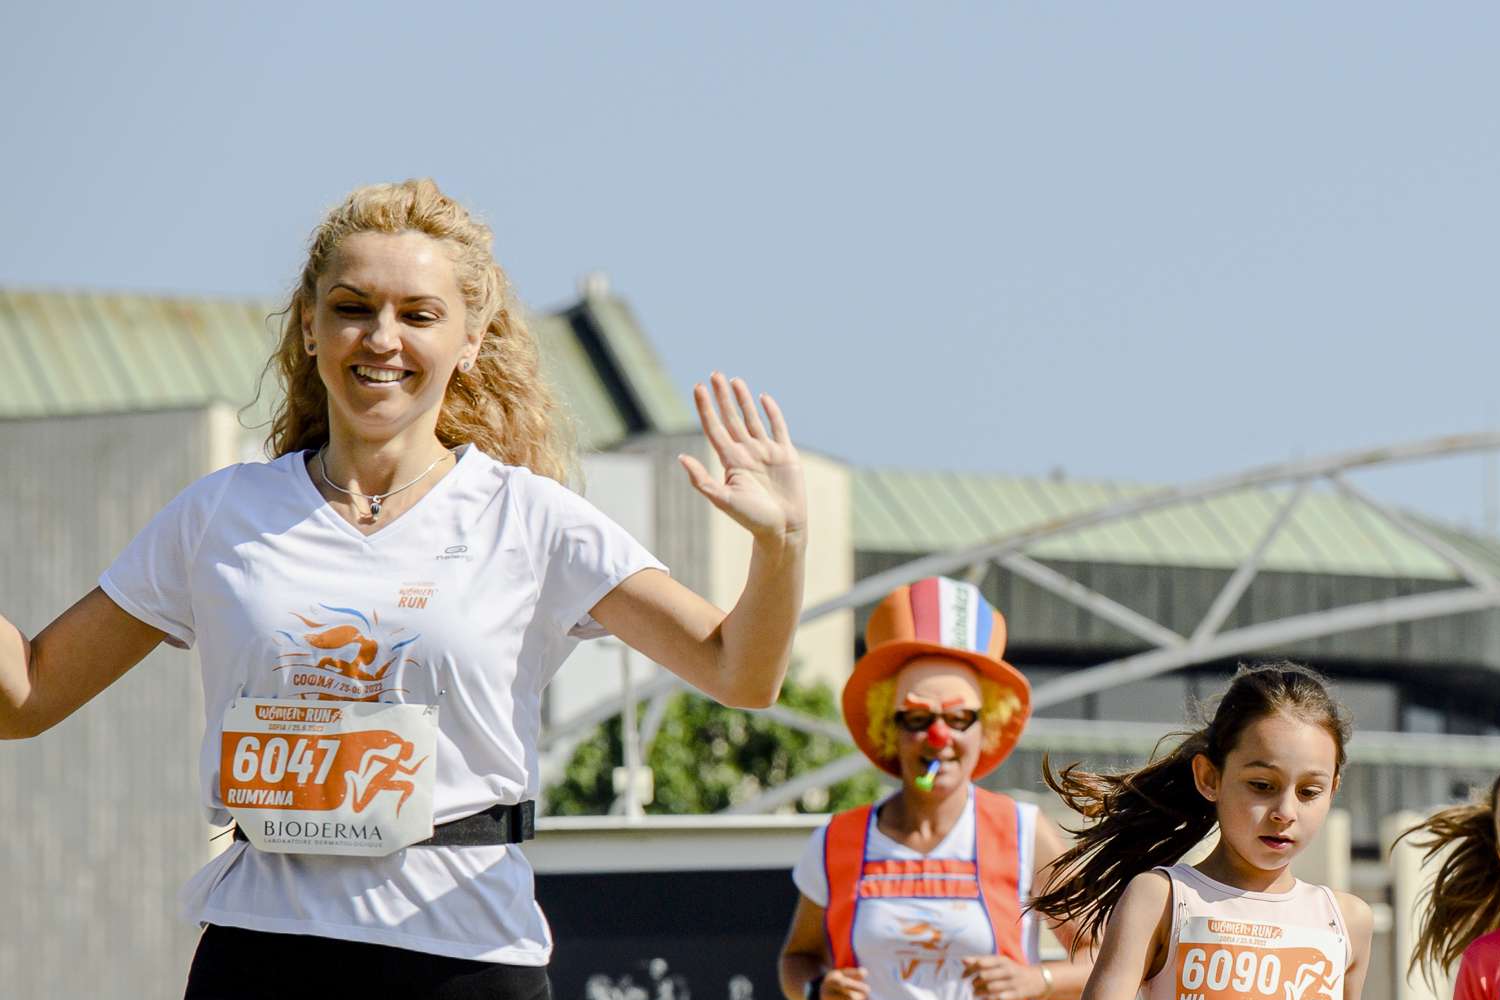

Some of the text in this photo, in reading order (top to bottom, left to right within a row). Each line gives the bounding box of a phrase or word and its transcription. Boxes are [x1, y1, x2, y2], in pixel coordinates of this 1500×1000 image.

[398, 596, 428, 609] RUN
[305, 708, 331, 722] RUN
[232, 736, 341, 785] 6047
[228, 788, 294, 806] RUMYANA
[264, 820, 382, 840] BIODERMA
[1252, 925, 1273, 938] RUN
[1182, 948, 1281, 995] 6090
